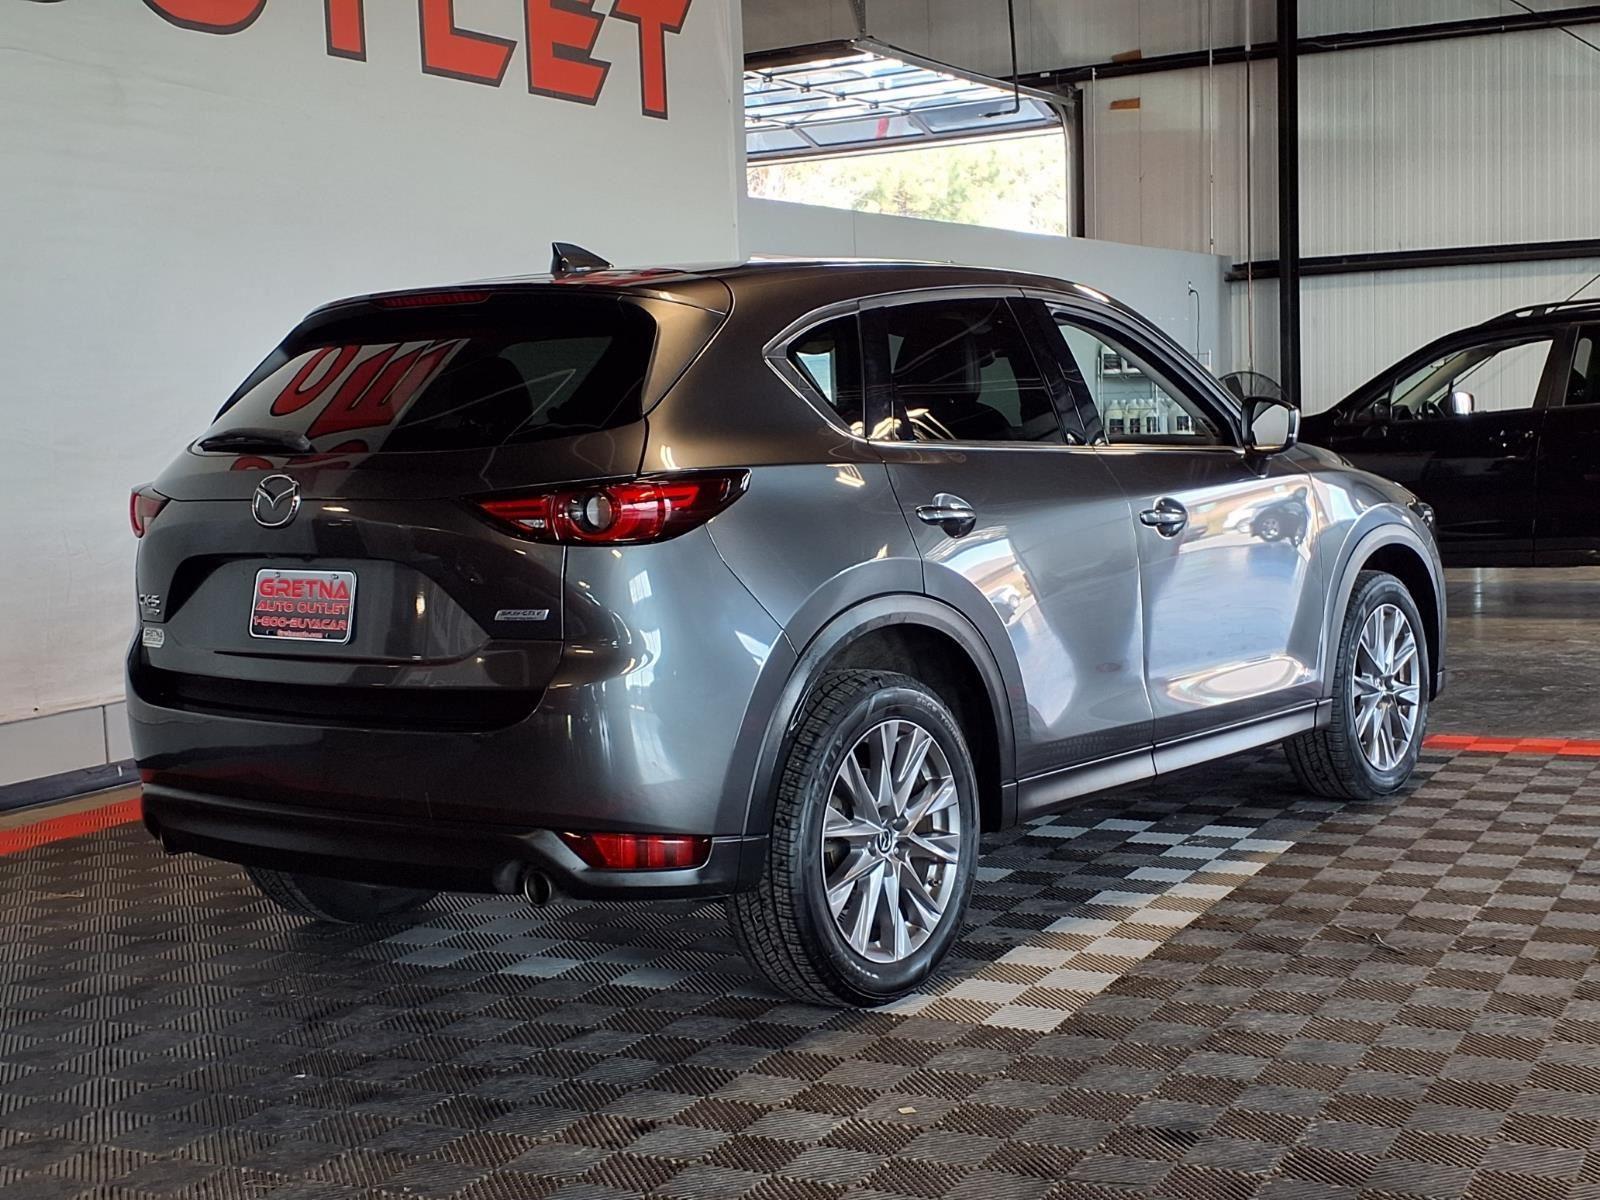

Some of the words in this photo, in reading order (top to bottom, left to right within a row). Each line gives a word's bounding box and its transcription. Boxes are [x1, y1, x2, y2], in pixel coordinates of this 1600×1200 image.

[20, 0, 693, 120] LET
[259, 578, 349, 600] GRETNA
[256, 601, 293, 612] AUTO
[297, 602, 348, 615] OUTLET
[253, 615, 347, 631] 1-800-BUYACAR
